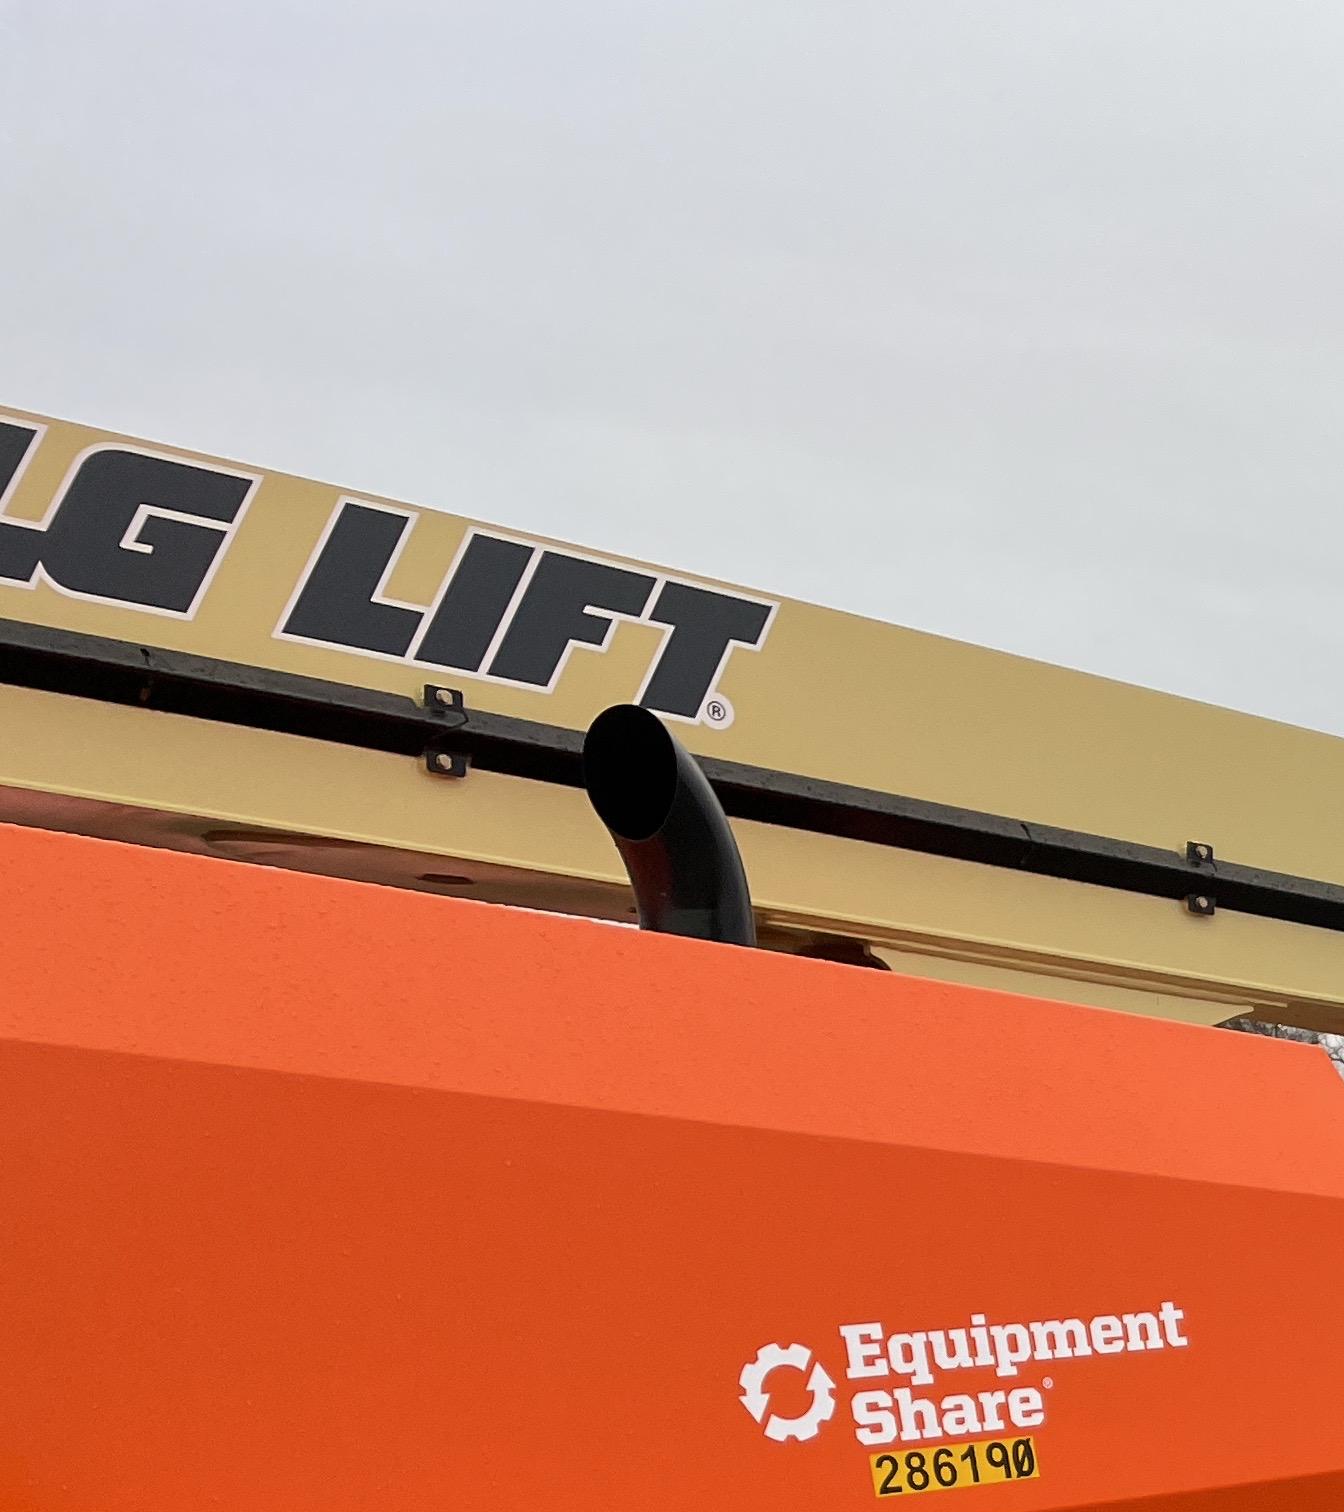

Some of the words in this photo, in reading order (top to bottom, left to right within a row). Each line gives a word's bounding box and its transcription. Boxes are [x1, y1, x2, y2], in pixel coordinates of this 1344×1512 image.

[839, 1300, 1189, 1386] Equipment
[850, 1386, 1045, 1446] Share
[874, 1437, 1036, 1495] 286190
